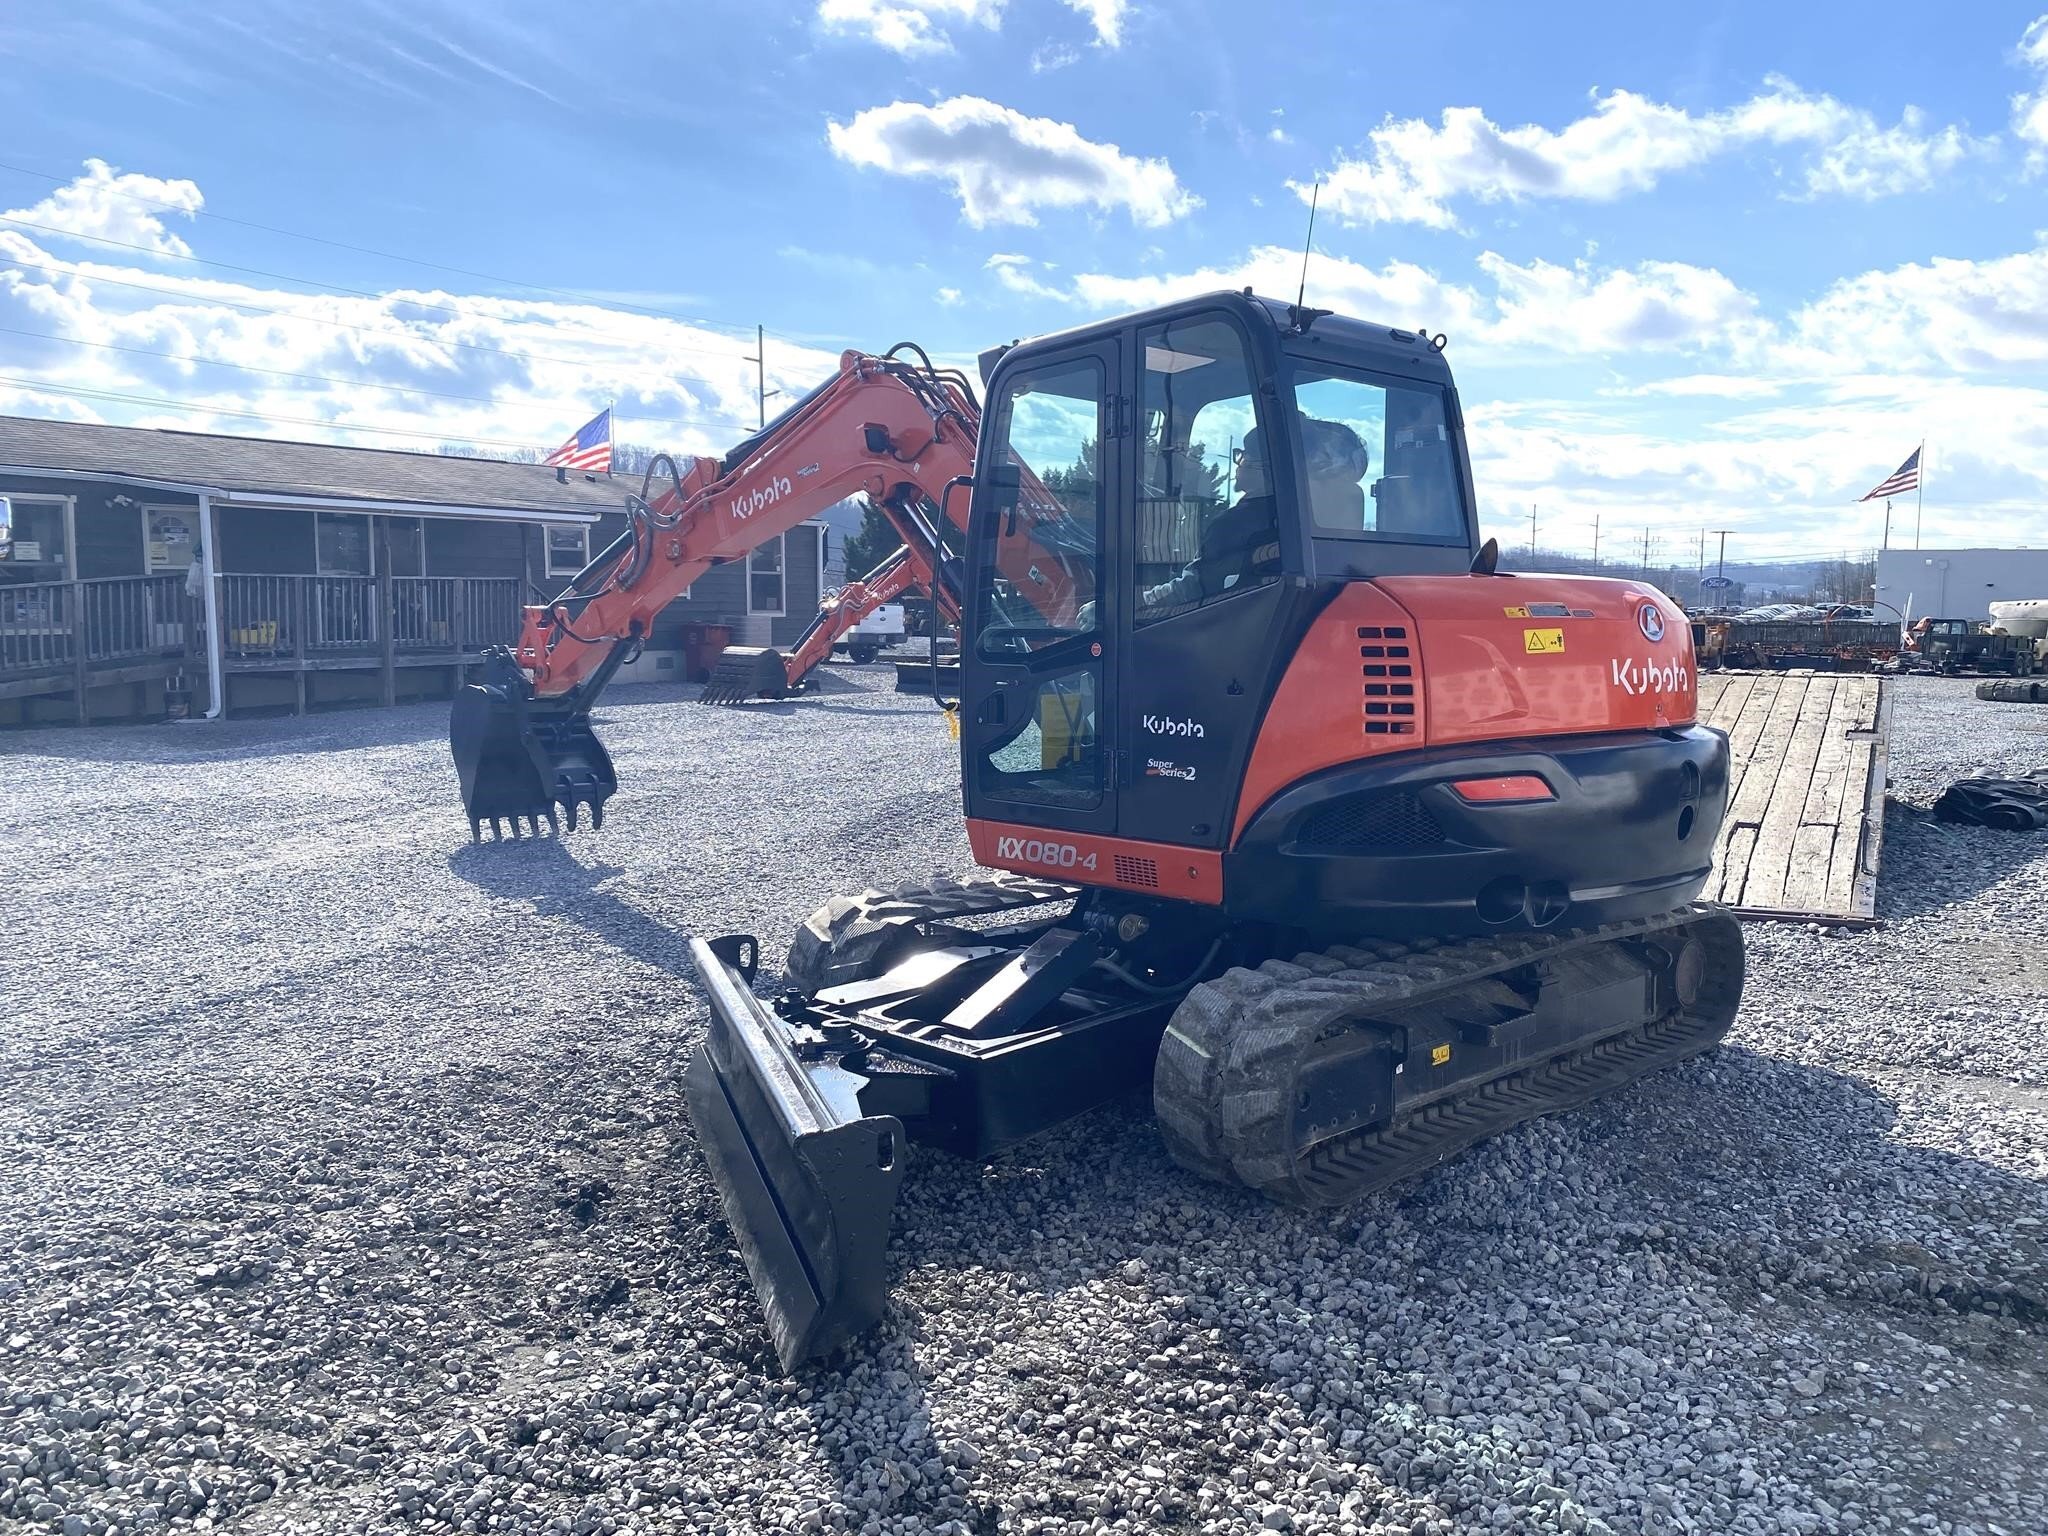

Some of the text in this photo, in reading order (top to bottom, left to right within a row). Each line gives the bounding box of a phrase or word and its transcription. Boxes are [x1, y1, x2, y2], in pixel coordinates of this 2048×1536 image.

[731, 476, 792, 519] Kubota
[1611, 657, 1688, 695] Kubota
[1143, 714, 1205, 738] Kubota
[1147, 758, 1174, 770] Super
[997, 836, 1097, 871] KX080-4
